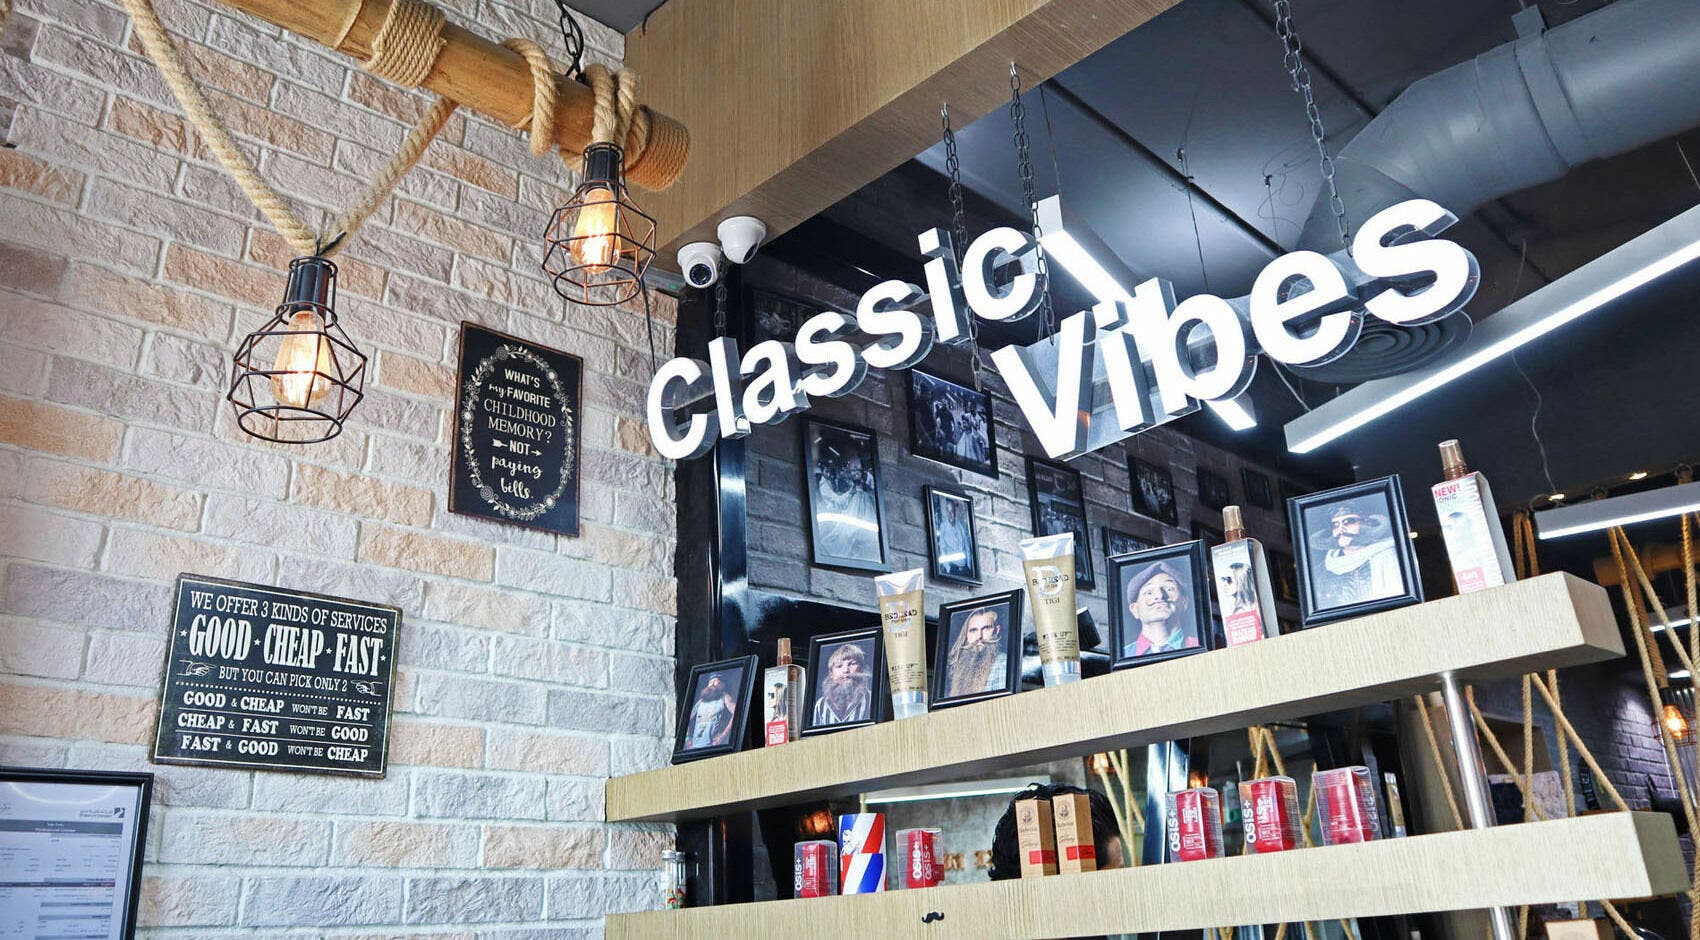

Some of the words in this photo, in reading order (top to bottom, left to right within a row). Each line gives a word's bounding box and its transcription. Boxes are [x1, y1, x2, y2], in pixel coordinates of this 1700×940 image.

[990, 198, 1475, 459] Vibes
[646, 226, 1042, 460] Classic
[504, 368, 540, 388] WHAT'S
[488, 384, 504, 398] my
[507, 387, 551, 408] FAVORITE
[484, 399, 556, 427] CHILDHOOD
[488, 417, 552, 444] MEMORY?
[509, 440, 531, 456] NOT
[491, 456, 543, 479] paying
[190, 590, 212, 610] WE
[216, 595, 258, 617] OFFER
[261, 601, 268, 616] 3
[271, 602, 308, 623] KINDS
[311, 609, 329, 625] OF
[330, 612, 387, 633] SERVICES
[189, 614, 251, 661] GOOD
[263, 623, 324, 669] CHEAP
[333, 632, 383, 677] FAST
[219, 665, 240, 681] BUT
[242, 669, 262, 684] YOU
[265, 671, 287, 686] CAN
[290, 673, 311, 688] PICK
[314, 677, 341, 692] ONLY
[342, 680, 347, 691] 2
[184, 691, 226, 708] GOOD
[231, 698, 237, 707] &
[240, 696, 284, 713] CHEAP
[336, 706, 370, 721] FAST
[178, 712, 226, 729] CHEAP
[228, 720, 235, 729] &
[241, 719, 279, 735] FAST
[331, 726, 369, 742] GOOD
[180, 736, 221, 750] FAST
[226, 741, 232, 749] &
[238, 740, 278, 756] GOOD
[327, 747, 368, 762] CHEAP
